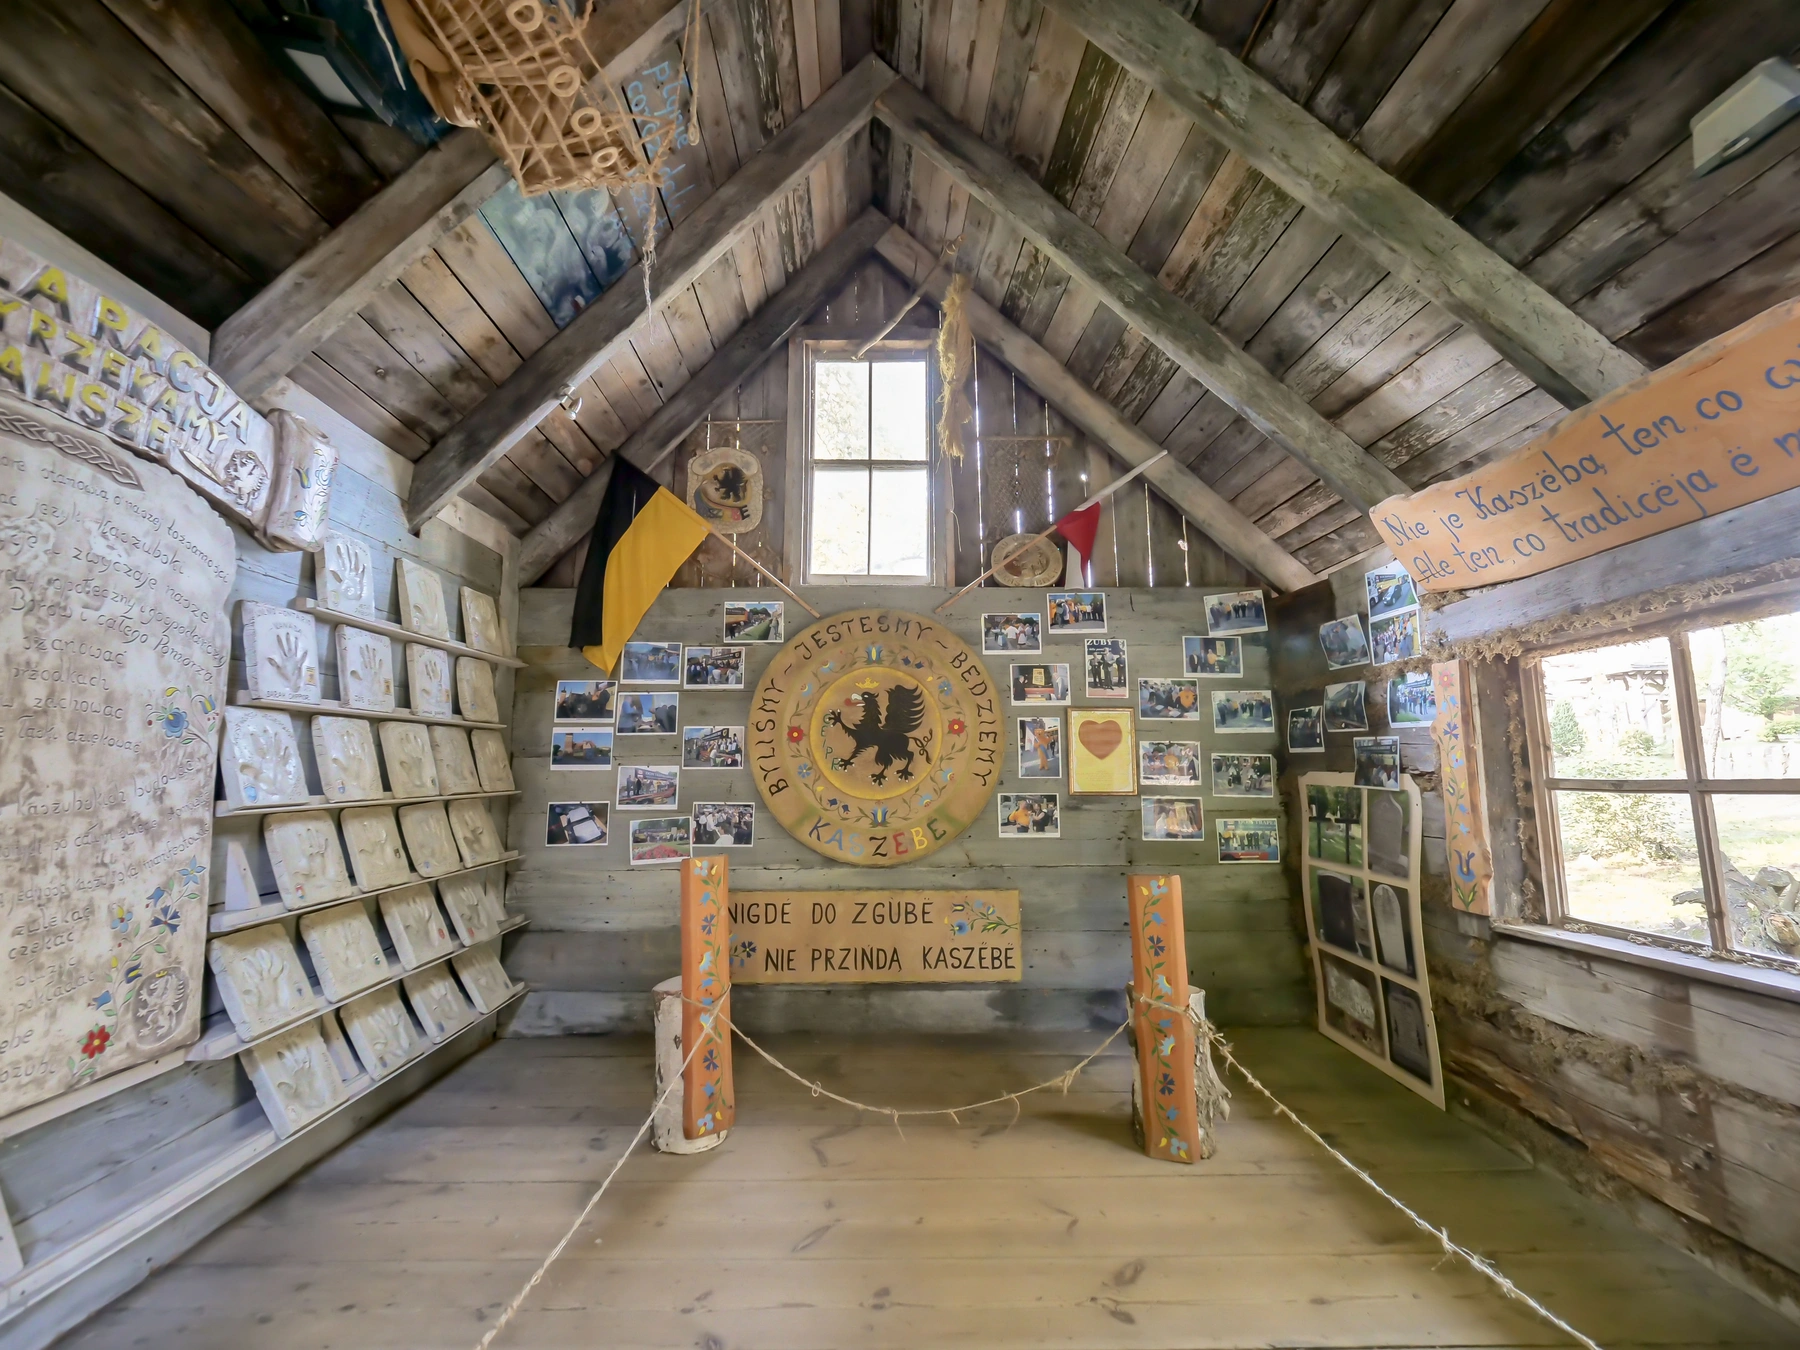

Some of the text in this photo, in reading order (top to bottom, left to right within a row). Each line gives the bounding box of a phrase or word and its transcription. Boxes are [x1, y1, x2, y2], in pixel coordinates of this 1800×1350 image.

[0, 264, 249, 444] ARACJA
[1381, 513, 1429, 547] Nie
[1432, 509, 1464, 544] je
[1696, 389, 1743, 420] co
[1413, 550, 1455, 584] Ale
[1512, 533, 1546, 558] co
[1727, 446, 1760, 477] ë
[764, 948, 797, 972] NIE
[812, 902, 837, 925] DO
